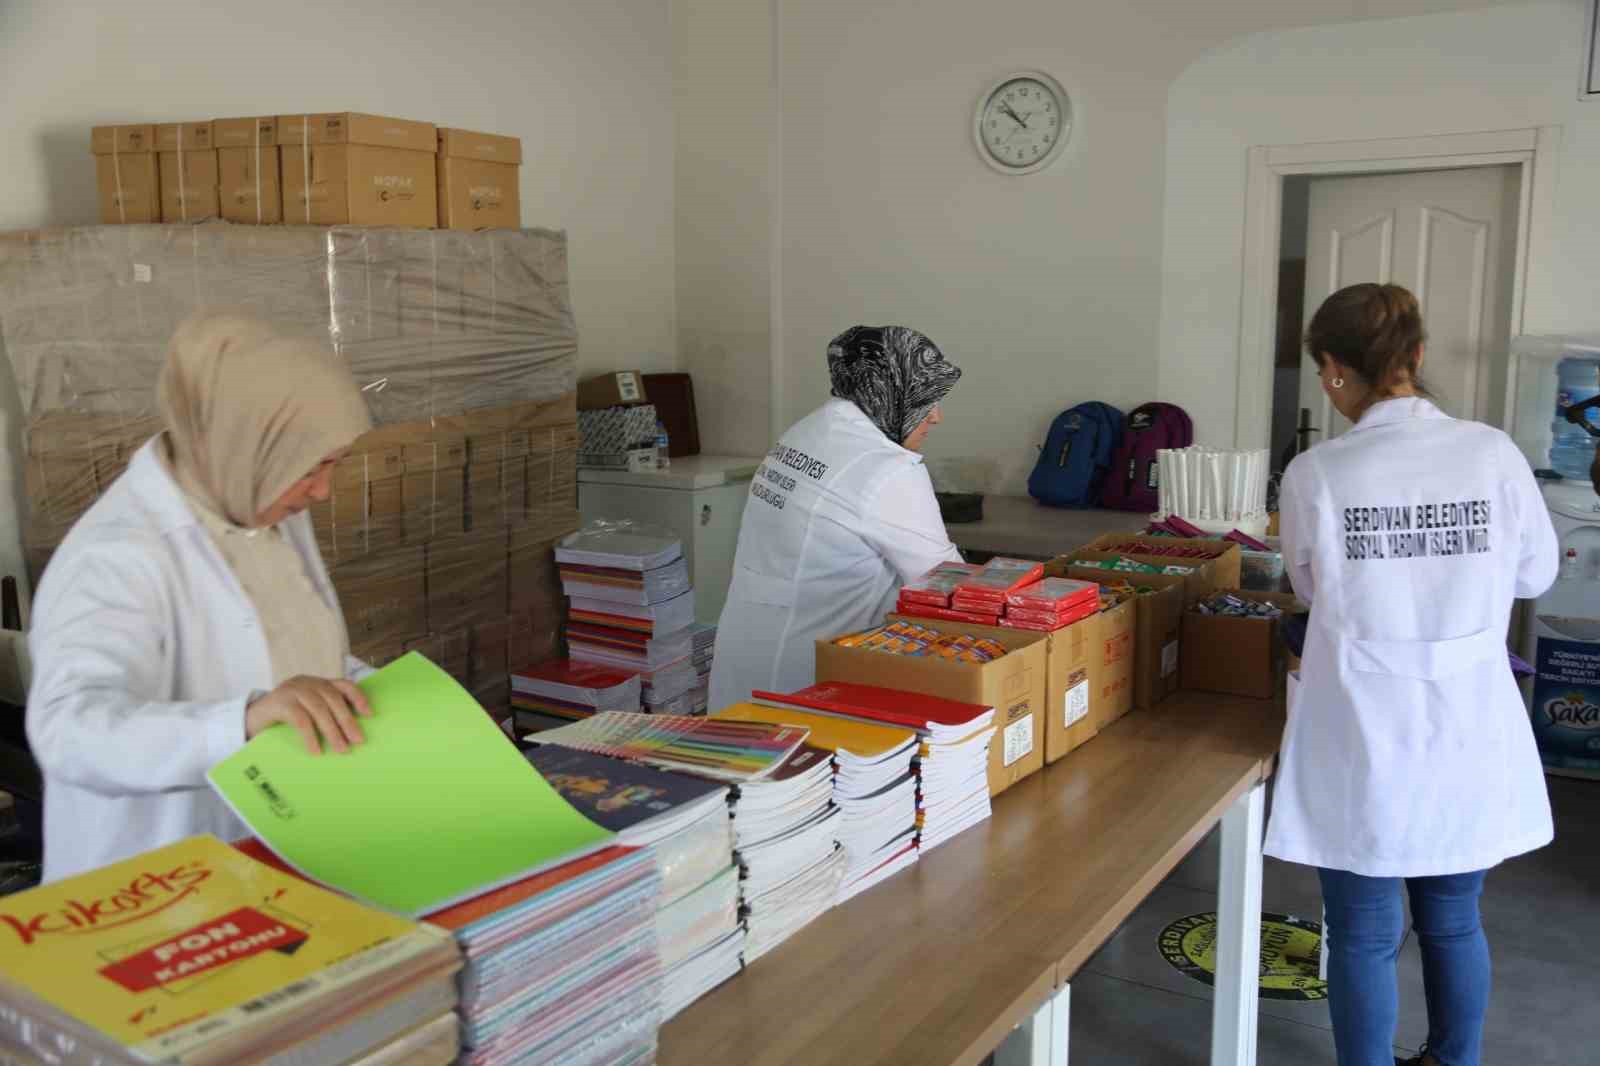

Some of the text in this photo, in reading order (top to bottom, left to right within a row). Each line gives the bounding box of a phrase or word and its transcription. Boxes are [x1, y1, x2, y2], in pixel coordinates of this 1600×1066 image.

[1416, 499, 1491, 529] BELEDİYESİ
[152, 920, 241, 962] FON
[153, 925, 287, 982] KARTONU
